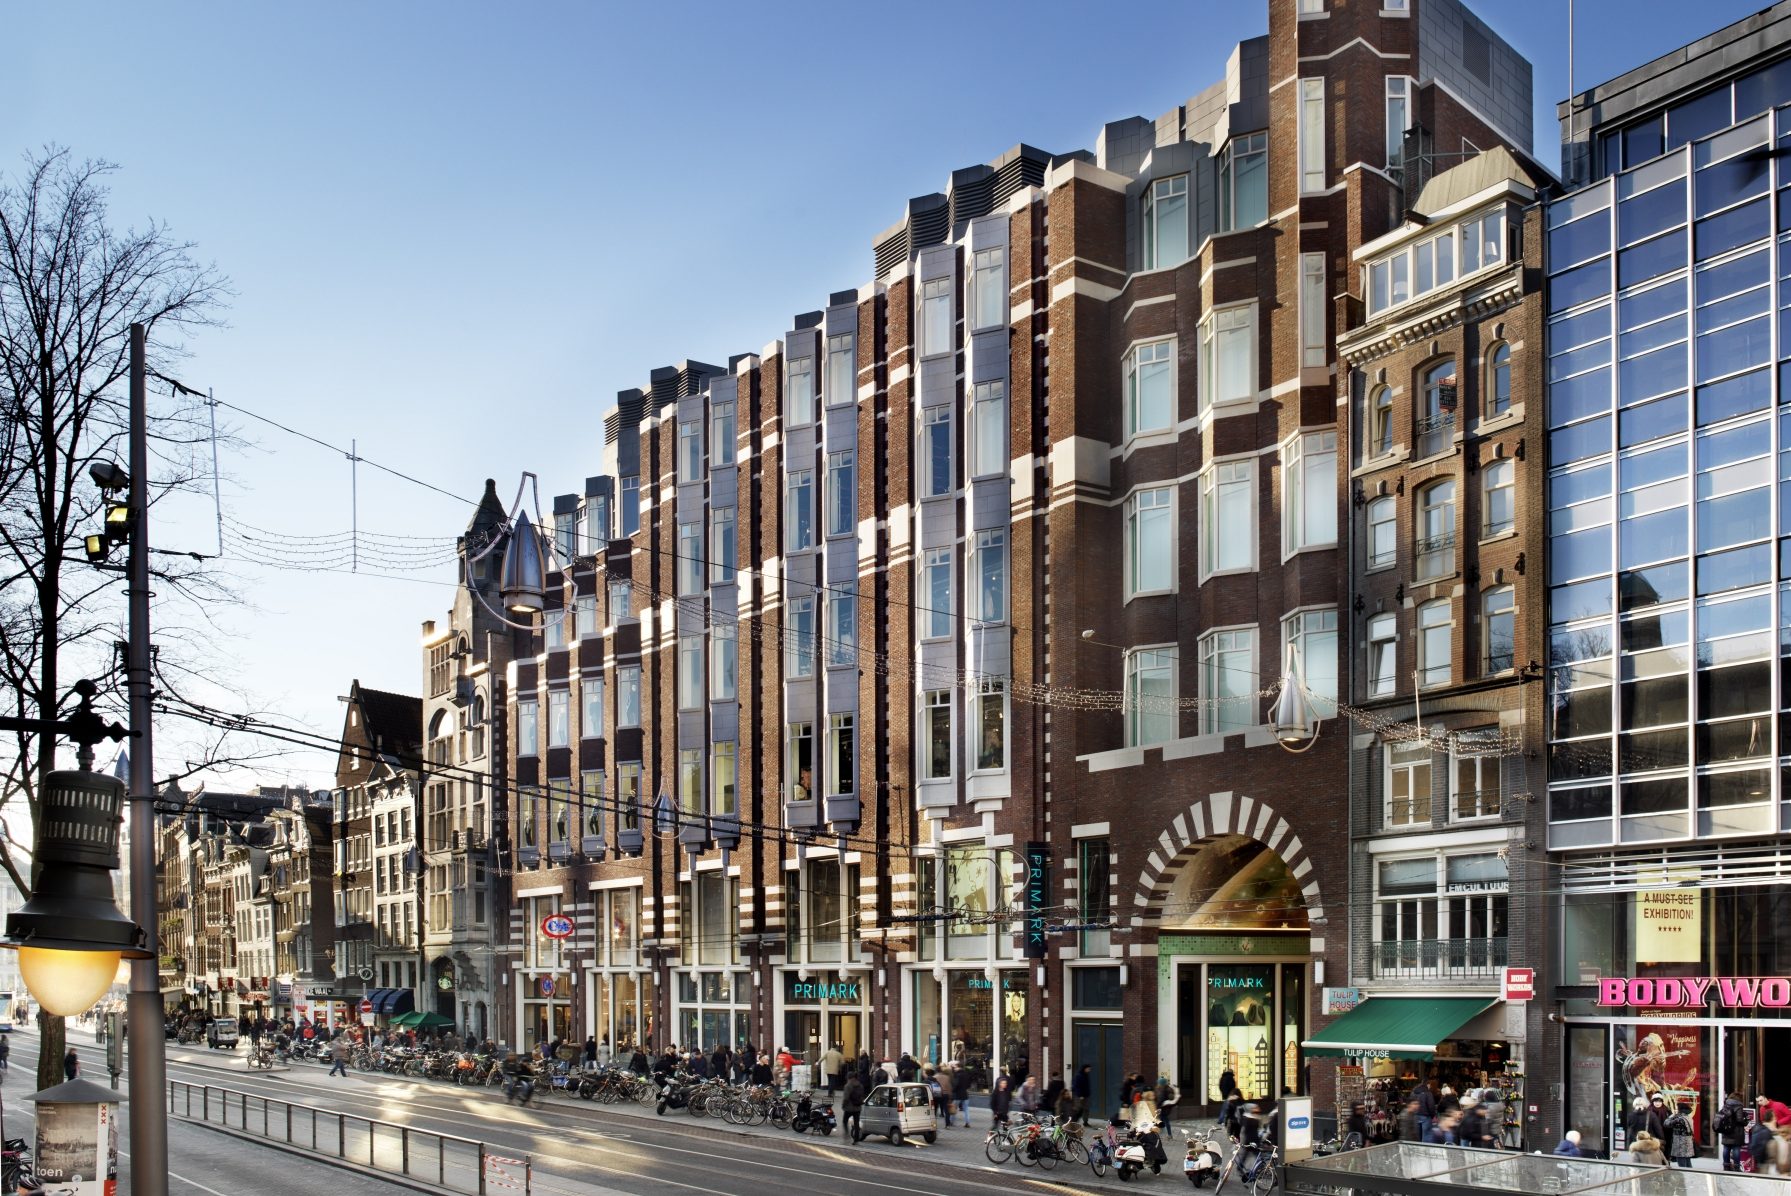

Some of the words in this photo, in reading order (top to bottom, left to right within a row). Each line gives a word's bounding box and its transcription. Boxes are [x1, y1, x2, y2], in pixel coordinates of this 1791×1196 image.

[1031, 855, 1042, 943] PRIMARK
[1644, 893, 1650, 903] A
[1652, 893, 1694, 905] MUST-SEE
[1643, 908, 1694, 919] EXHIBITION!
[968, 979, 1010, 989] PRIMK
[794, 983, 858, 998] PRIMARK
[1333, 991, 1353, 999] TULIP
[1599, 978, 1709, 1007] BODY
[1713, 977, 1791, 1007] WO
[1330, 1001, 1356, 1009] HOUSE
[1344, 1049, 1363, 1057] TULIP
[1364, 1050, 1389, 1058] HOUSE
[37, 1168, 63, 1177] toen
